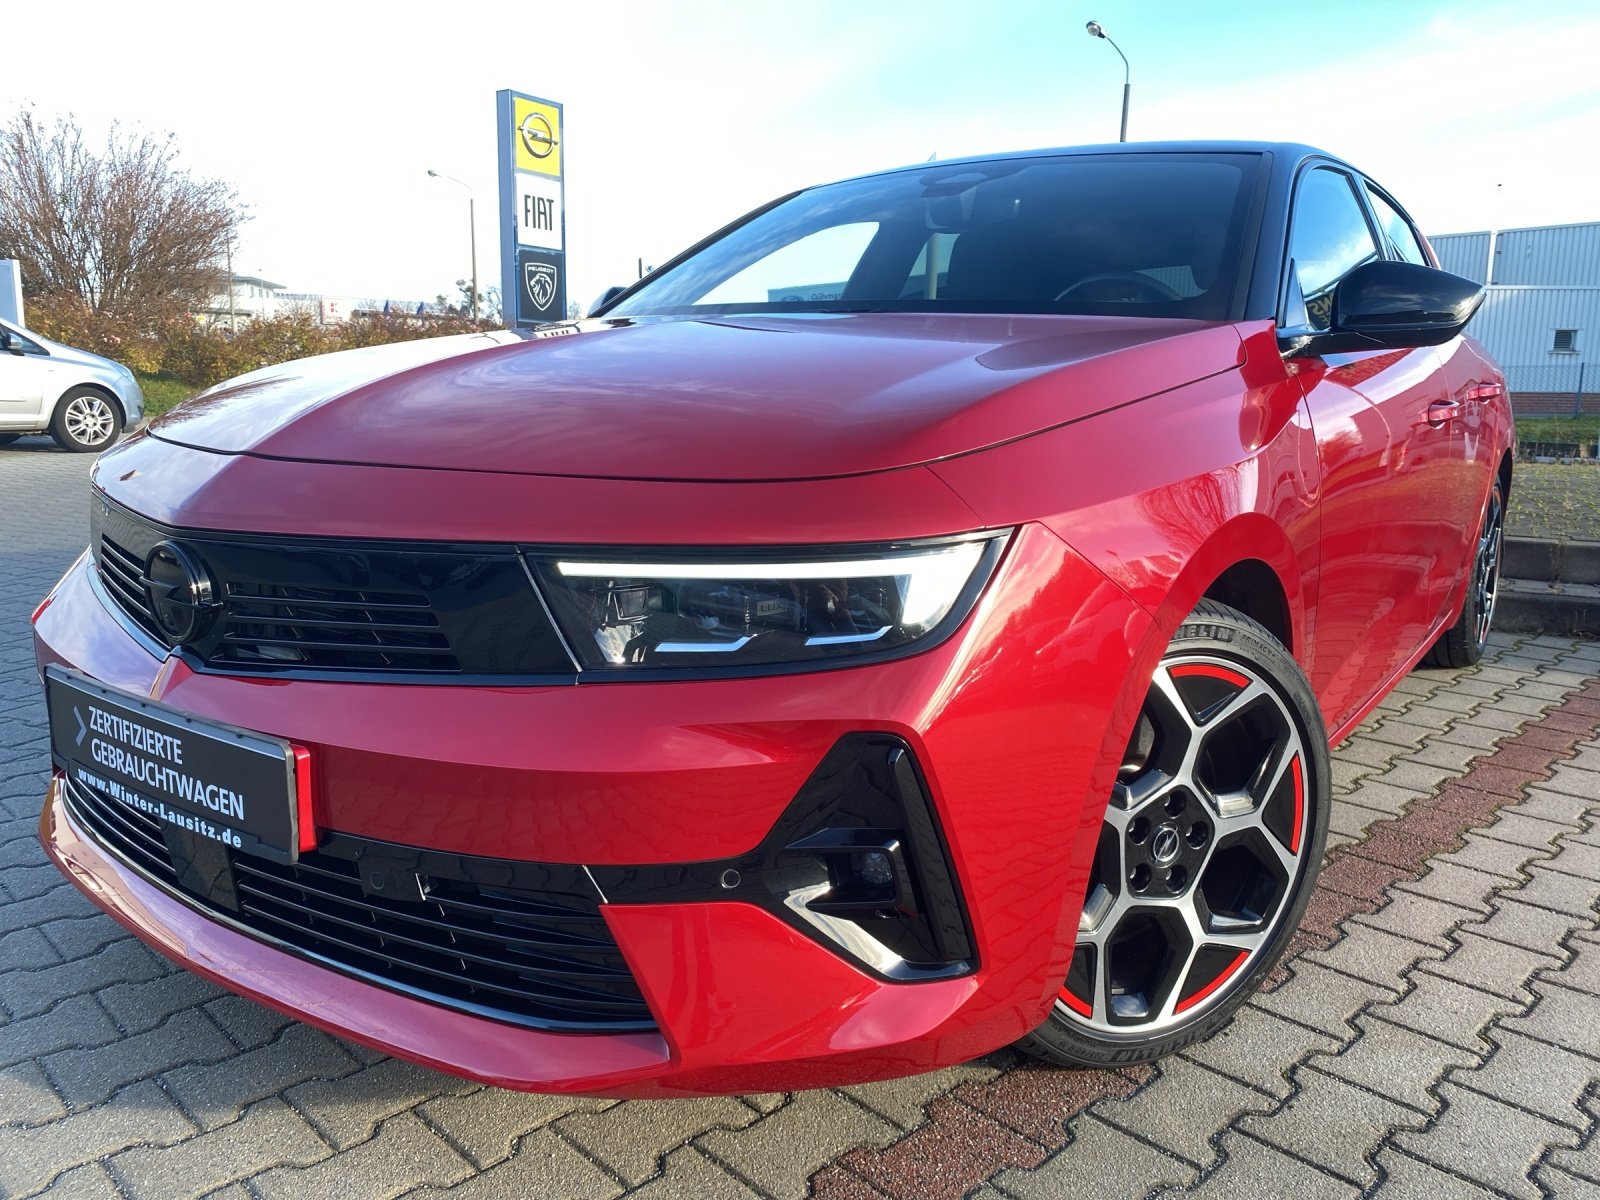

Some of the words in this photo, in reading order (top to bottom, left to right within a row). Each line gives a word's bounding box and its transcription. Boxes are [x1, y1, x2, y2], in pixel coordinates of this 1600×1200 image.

[524, 194, 554, 231] FIAT
[527, 266, 554, 274] PEUGEOT
[1173, 625, 1232, 641] HELIN
[88, 705, 183, 765] ZERTIFIZIERTE
[91, 738, 245, 821] GEBRAUCHTWAGEN
[78, 768, 242, 848] www.Winter-Lausitz.de
